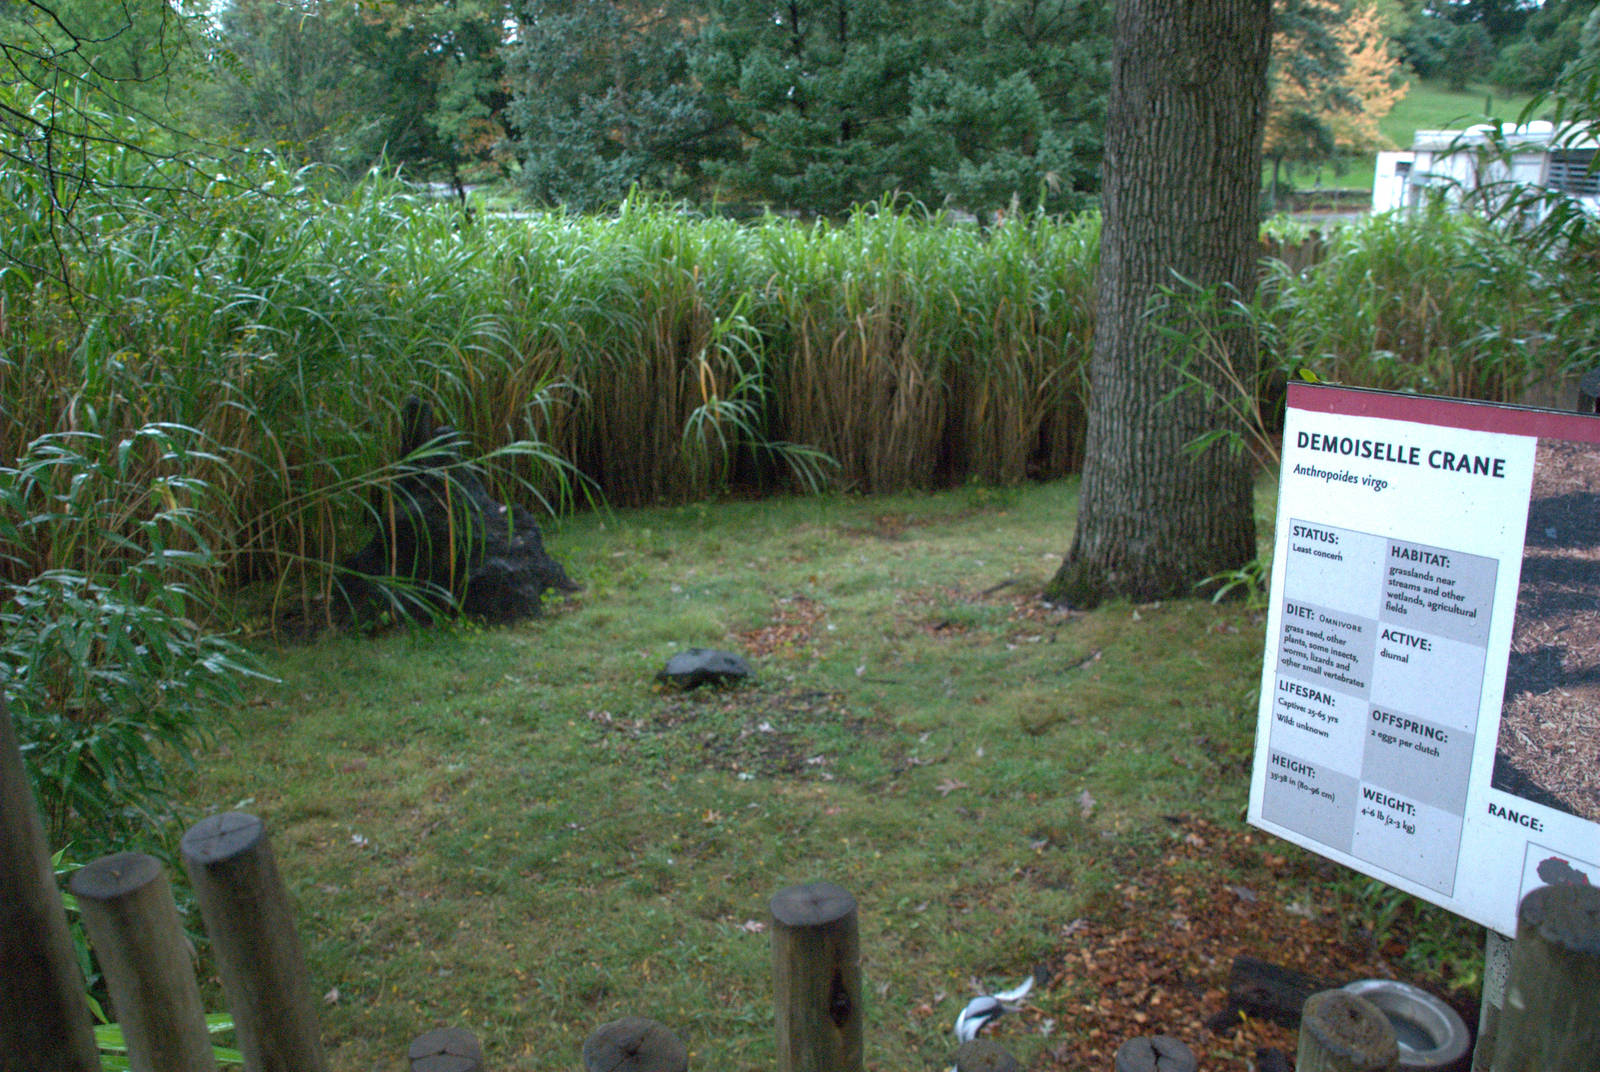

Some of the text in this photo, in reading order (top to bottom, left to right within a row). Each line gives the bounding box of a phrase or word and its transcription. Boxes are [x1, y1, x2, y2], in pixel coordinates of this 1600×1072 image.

[1297, 431, 1506, 478] DEMOISELLE CRANE
[1293, 464, 1388, 491] Anthropoides virgo
[1293, 526, 1339, 544] STATUS:
[1293, 543, 1343, 561] Least concern
[1392, 546, 1450, 568] HABITAT:
[1390, 567, 1456, 586] grasslands near
[1388, 578, 1465, 602] streams and other
[1287, 604, 1314, 620] DIET:
[1386, 601, 1407, 614] fields
[1387, 591, 1477, 618] wetlands, agricultural
[1285, 624, 1346, 645] grass seed, other
[1382, 629, 1432, 651] ACTIVE:
[1283, 647, 1350, 671] worms, lizards and
[1284, 634, 1358, 663] plants, some insects,
[1380, 648, 1409, 663] diurnal
[1281, 657, 1364, 688] other small vertebrates
[1279, 680, 1335, 706] LIFESPAN:
[1278, 698, 1338, 723] Captive: 25-65 yrs
[1277, 713, 1329, 738] Wild: unknown
[1372, 710, 1448, 743] OFFSPRING:
[1378, 732, 1397, 744] eggs
[1399, 739, 1412, 748] per
[1415, 742, 1440, 757] clutch
[1272, 754, 1315, 778] HEIGHT:
[1289, 777, 1296, 785] in
[1321, 791, 1335, 802] cm)
[1363, 787, 1415, 816] WEIGHT:
[1361, 808, 1415, 834] 4-6 lb (2-3 kg)
[1488, 803, 1543, 832] RANGE:
